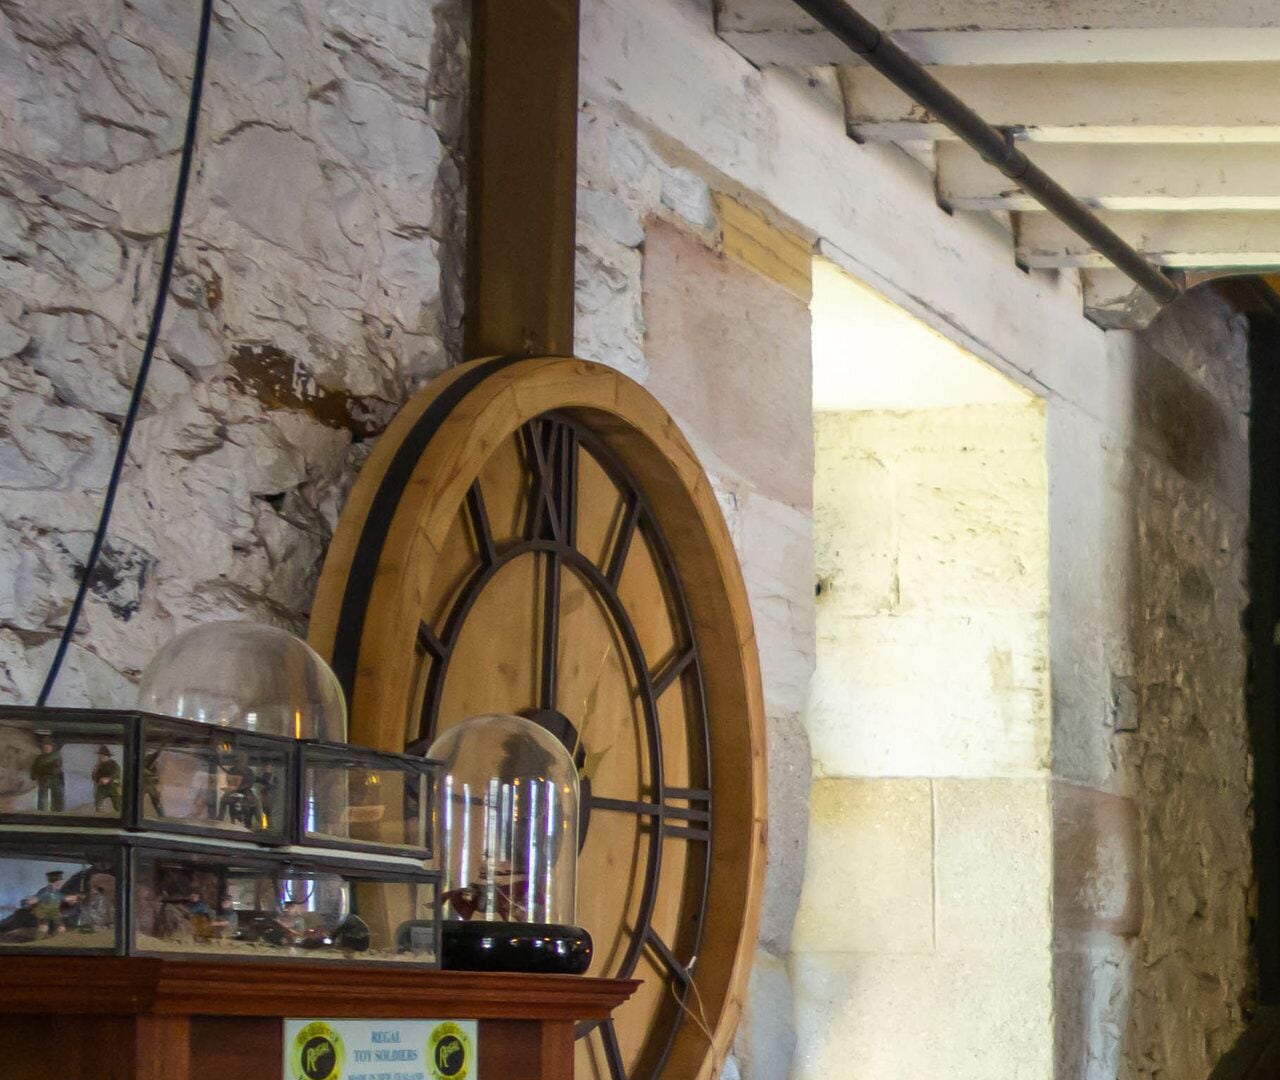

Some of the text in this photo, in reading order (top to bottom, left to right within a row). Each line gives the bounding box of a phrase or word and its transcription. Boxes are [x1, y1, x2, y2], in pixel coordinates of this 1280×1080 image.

[372, 1031, 400, 1043] REGAL
[354, 1049, 418, 1062] TOY SOLDIERS
